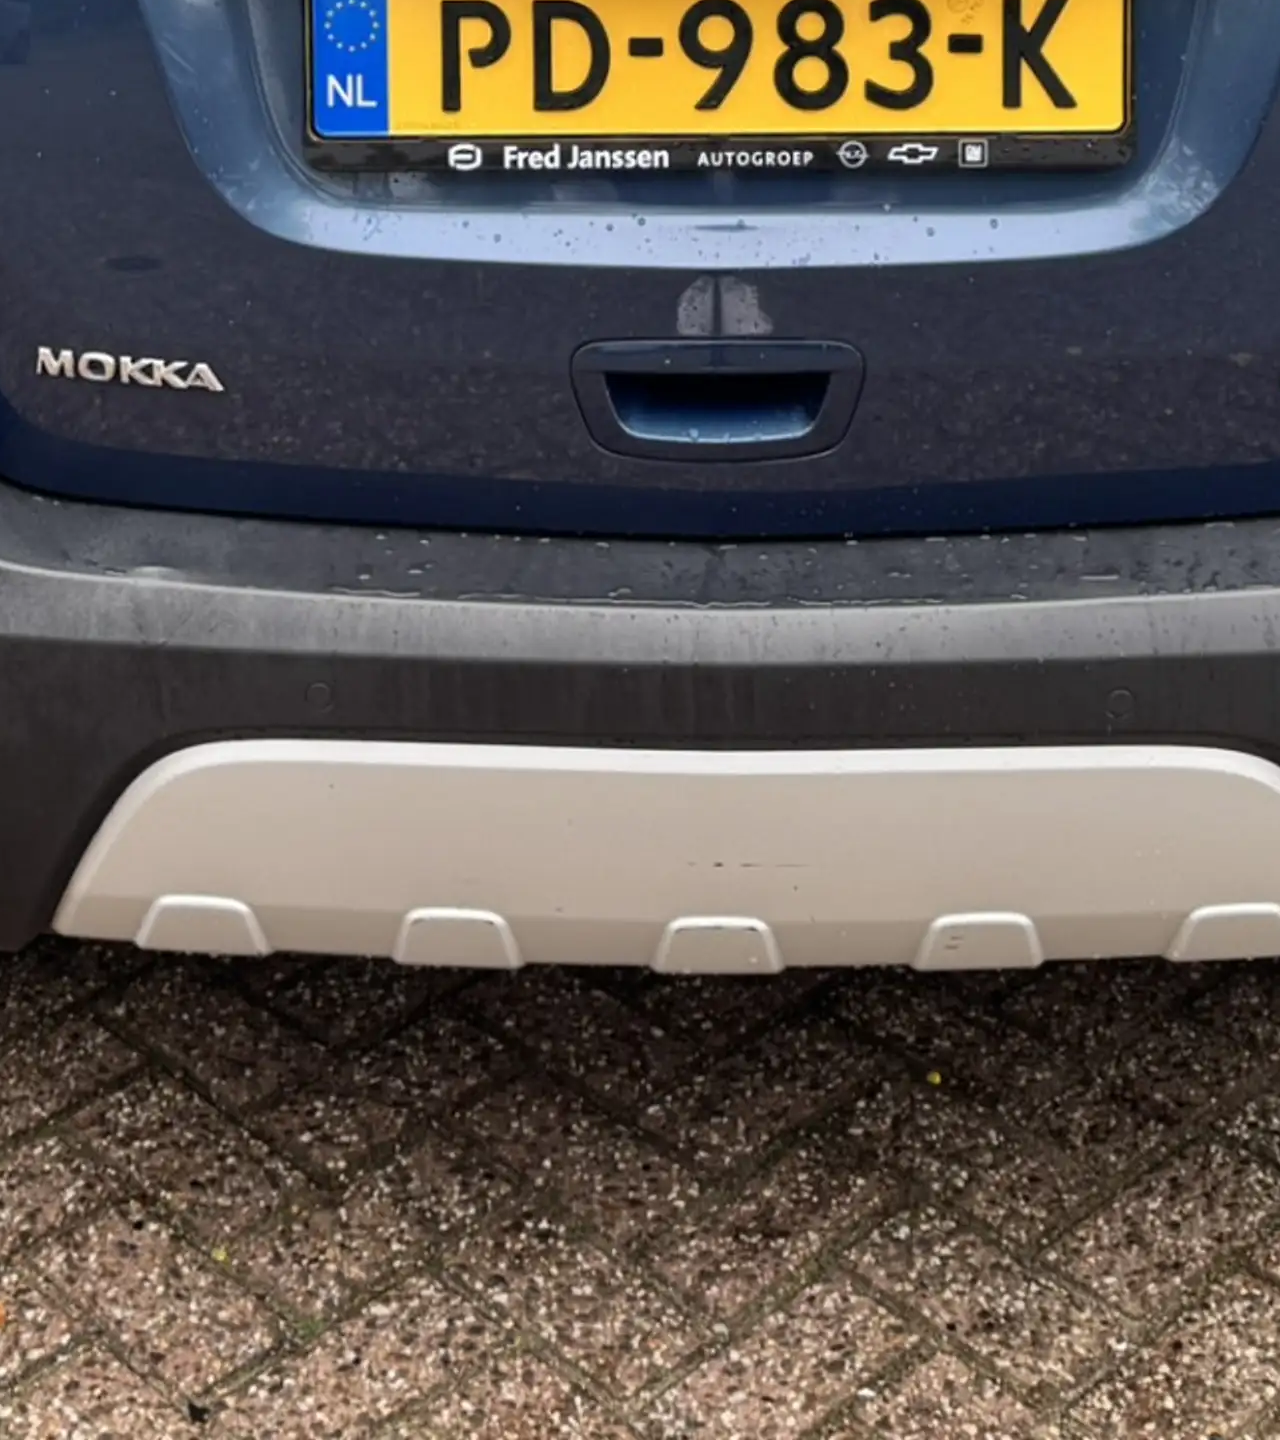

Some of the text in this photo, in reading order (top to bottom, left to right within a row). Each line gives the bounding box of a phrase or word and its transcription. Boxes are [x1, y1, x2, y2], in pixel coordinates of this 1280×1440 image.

[325, 75, 378, 109] NL
[503, 143, 814, 170] Fred Janssen AUTOGROEP
[36, 345, 225, 392] MOKKA
